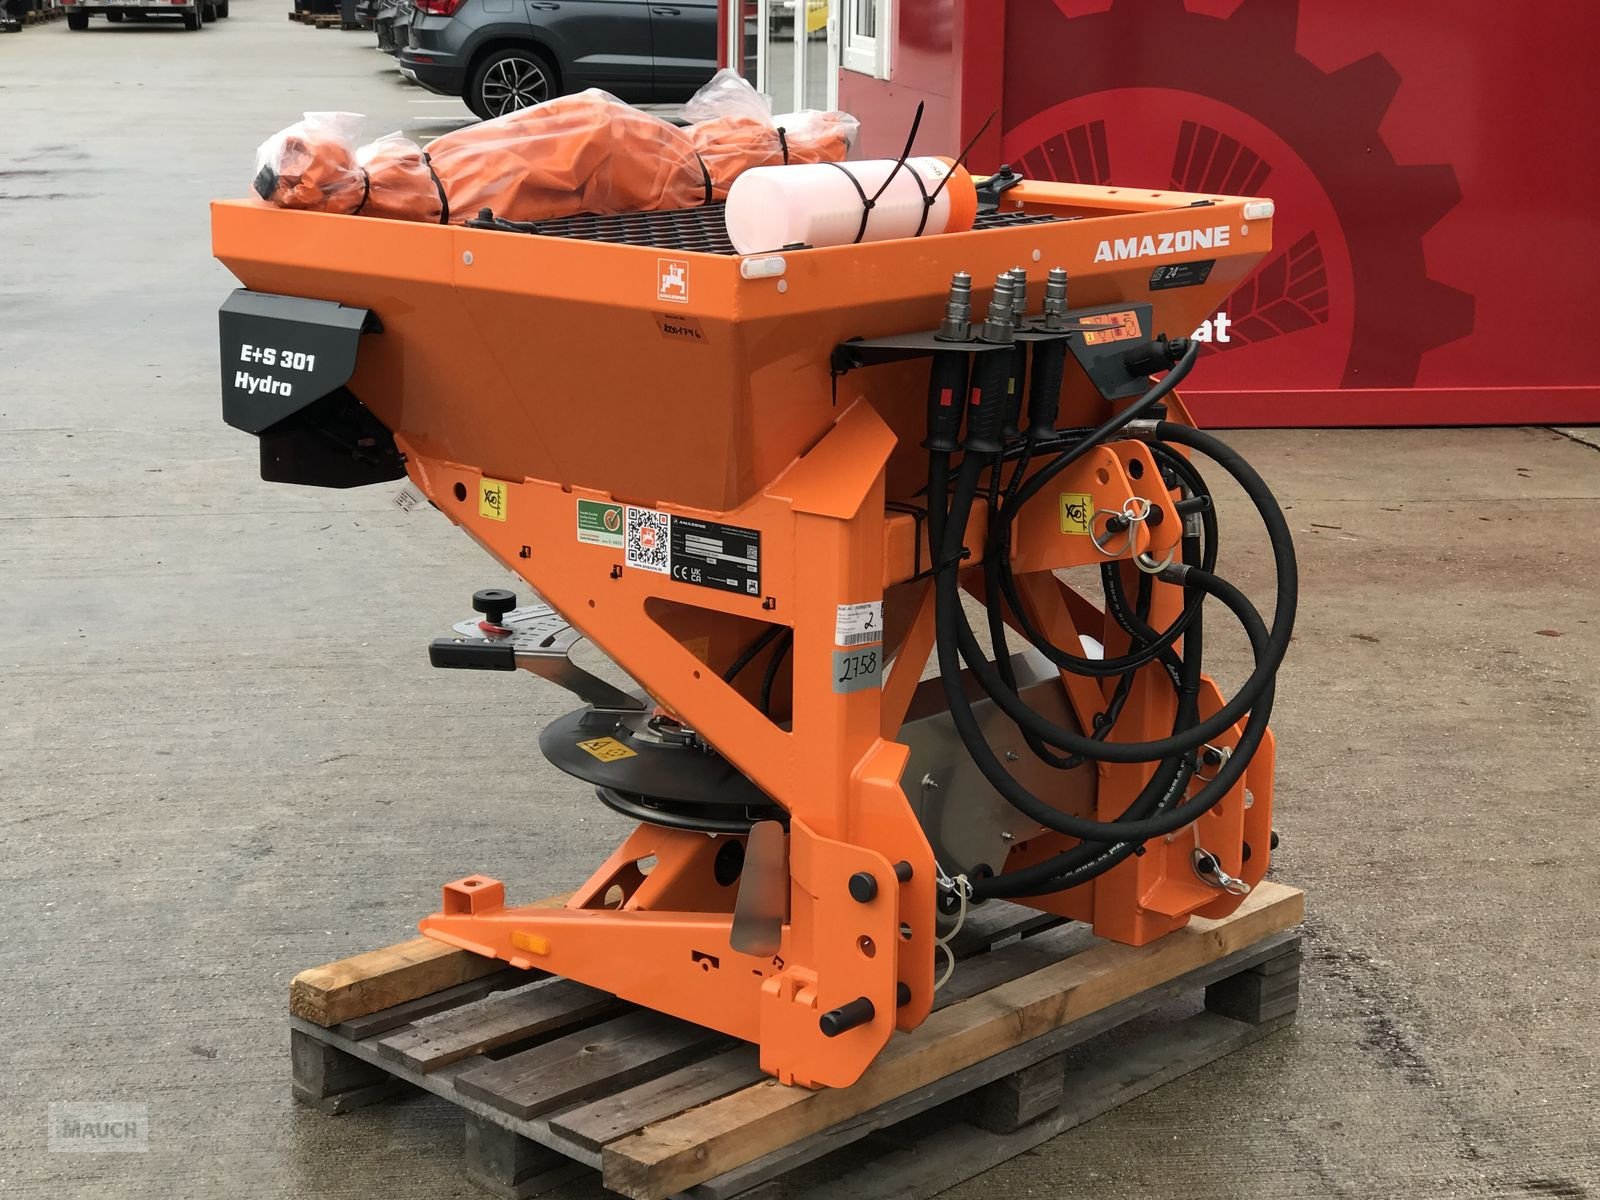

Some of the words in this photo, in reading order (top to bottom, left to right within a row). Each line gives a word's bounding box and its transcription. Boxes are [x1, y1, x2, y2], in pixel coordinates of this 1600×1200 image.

[1093, 225, 1231, 264] AMAZONE
[1164, 266, 1179, 279] 24
[240, 343, 277, 366] E+S
[280, 350, 315, 372] 301
[234, 370, 292, 397] Hydro
[678, 520, 707, 529] AMAZONE
[838, 651, 877, 683] 2758
